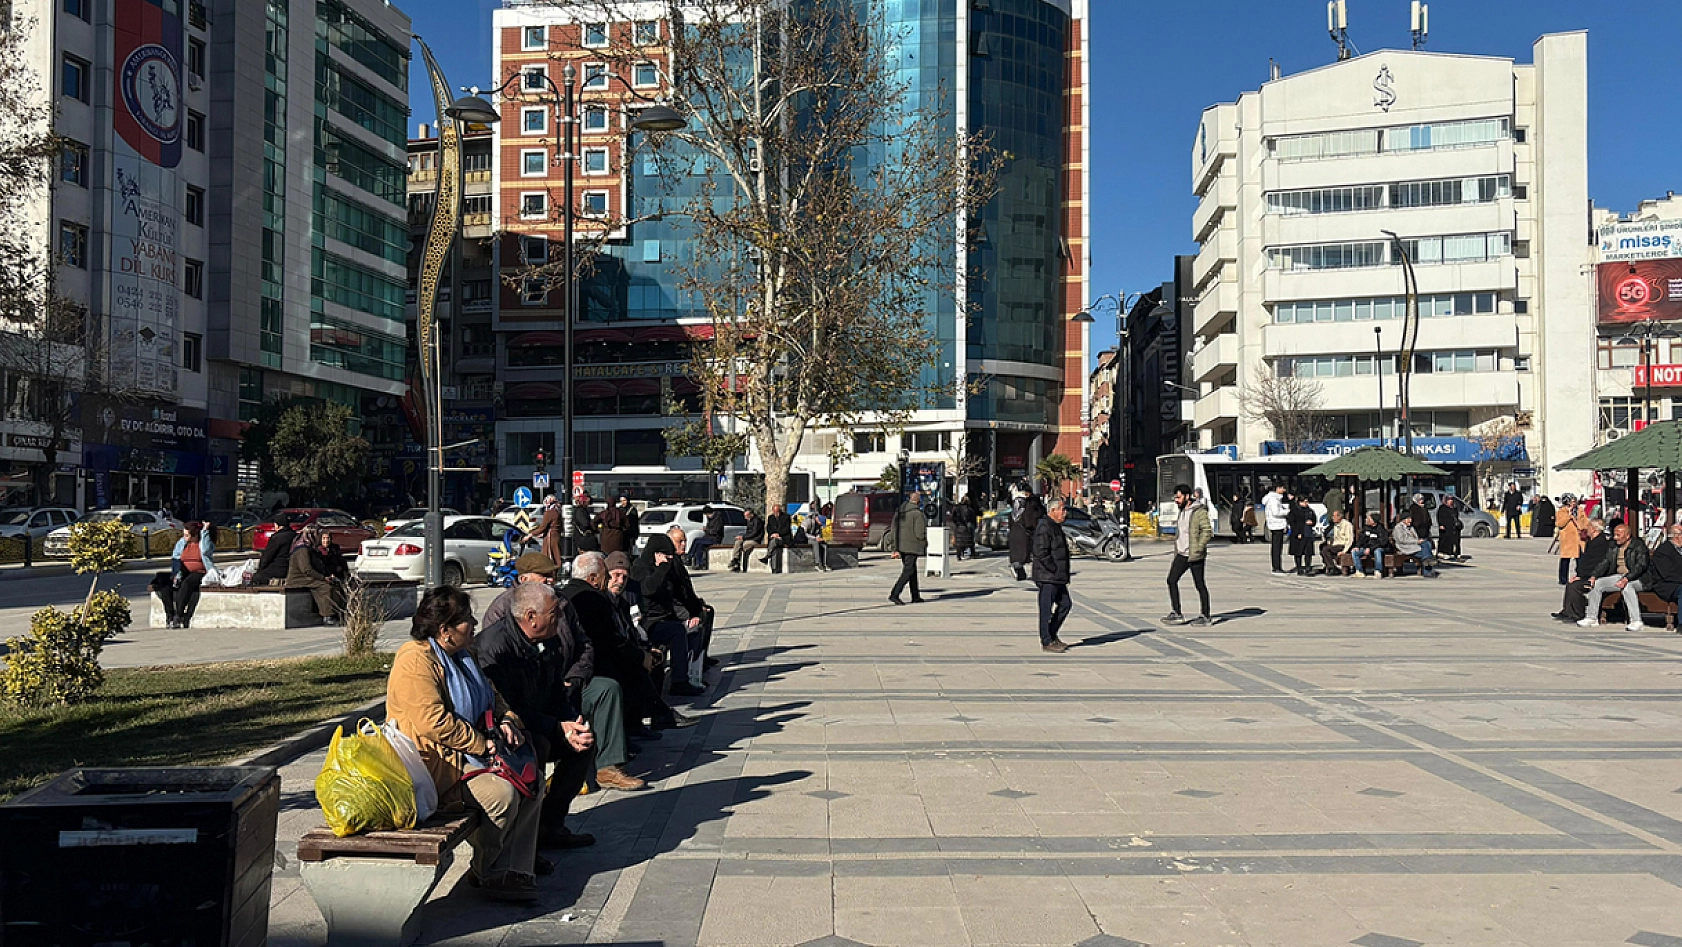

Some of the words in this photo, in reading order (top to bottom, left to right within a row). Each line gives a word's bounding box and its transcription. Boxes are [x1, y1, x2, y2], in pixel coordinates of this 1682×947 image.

[1620, 235, 1672, 249] misaş
[130, 239, 176, 265] YABANC
[1606, 250, 1669, 260] MARKETLERDE
[121, 255, 146, 276] DİL
[1620, 286, 1645, 300] 5G
[575, 363, 645, 377] HAYALCAFE
[1637, 369, 1645, 383] 1
[121, 419, 132, 430] EV
